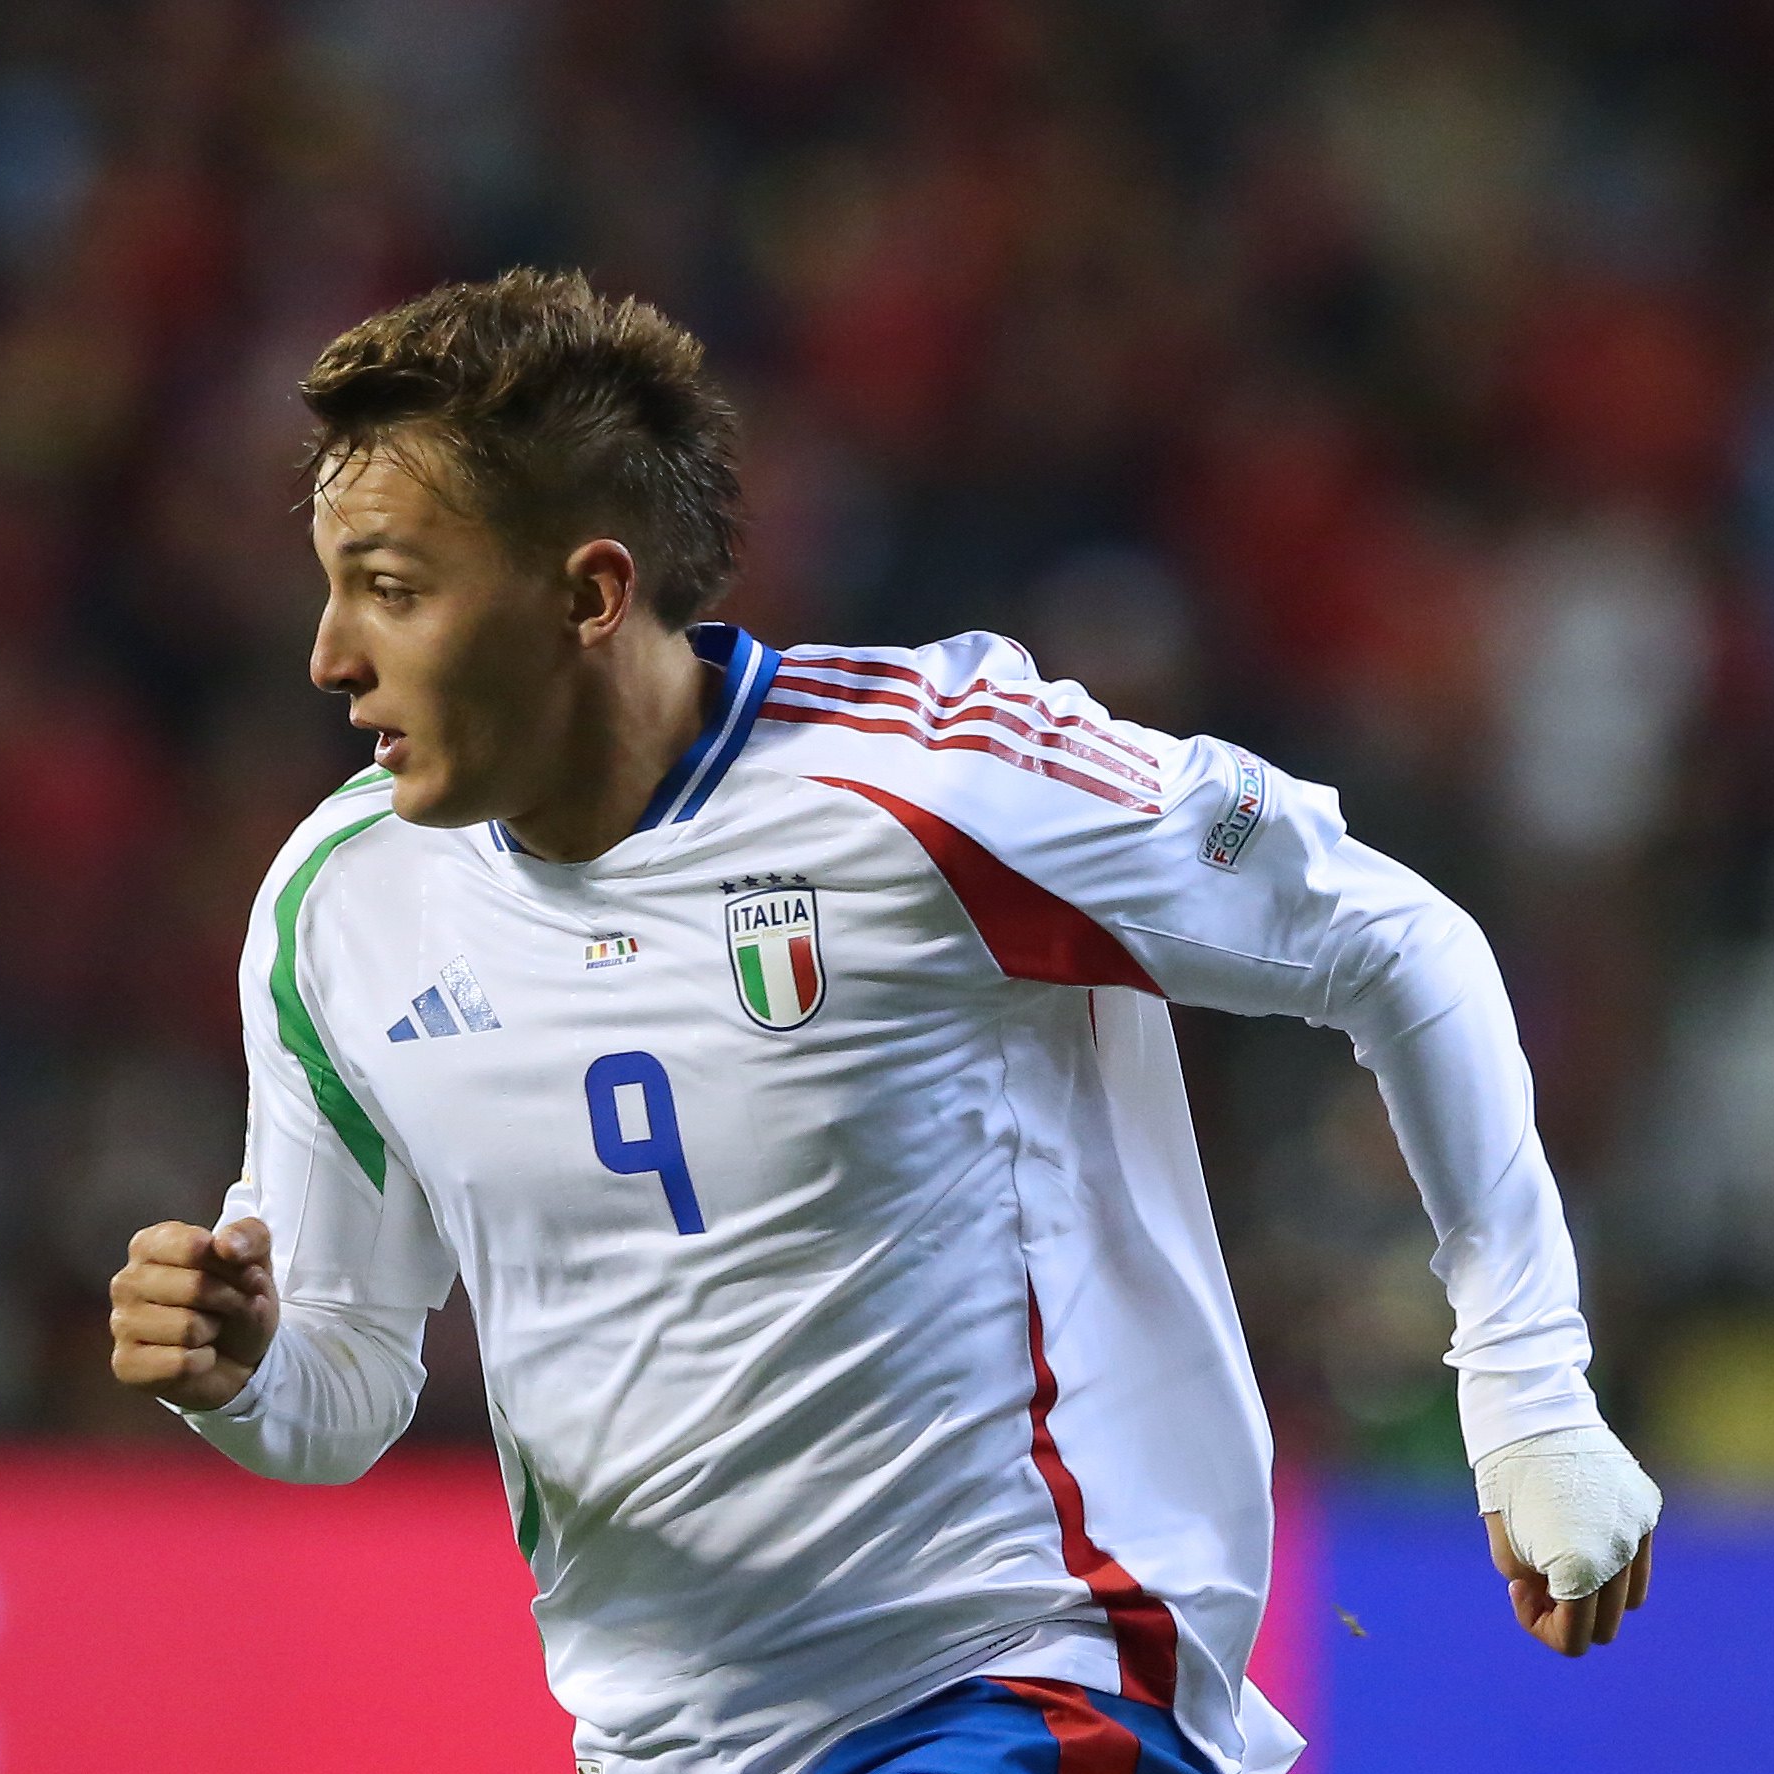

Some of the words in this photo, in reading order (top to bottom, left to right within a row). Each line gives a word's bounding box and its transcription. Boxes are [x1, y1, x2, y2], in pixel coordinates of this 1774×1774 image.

[1203, 822, 1226, 859] UEFA
[732, 898, 809, 932] ITALIA
[584, 1050, 706, 1235] 9
